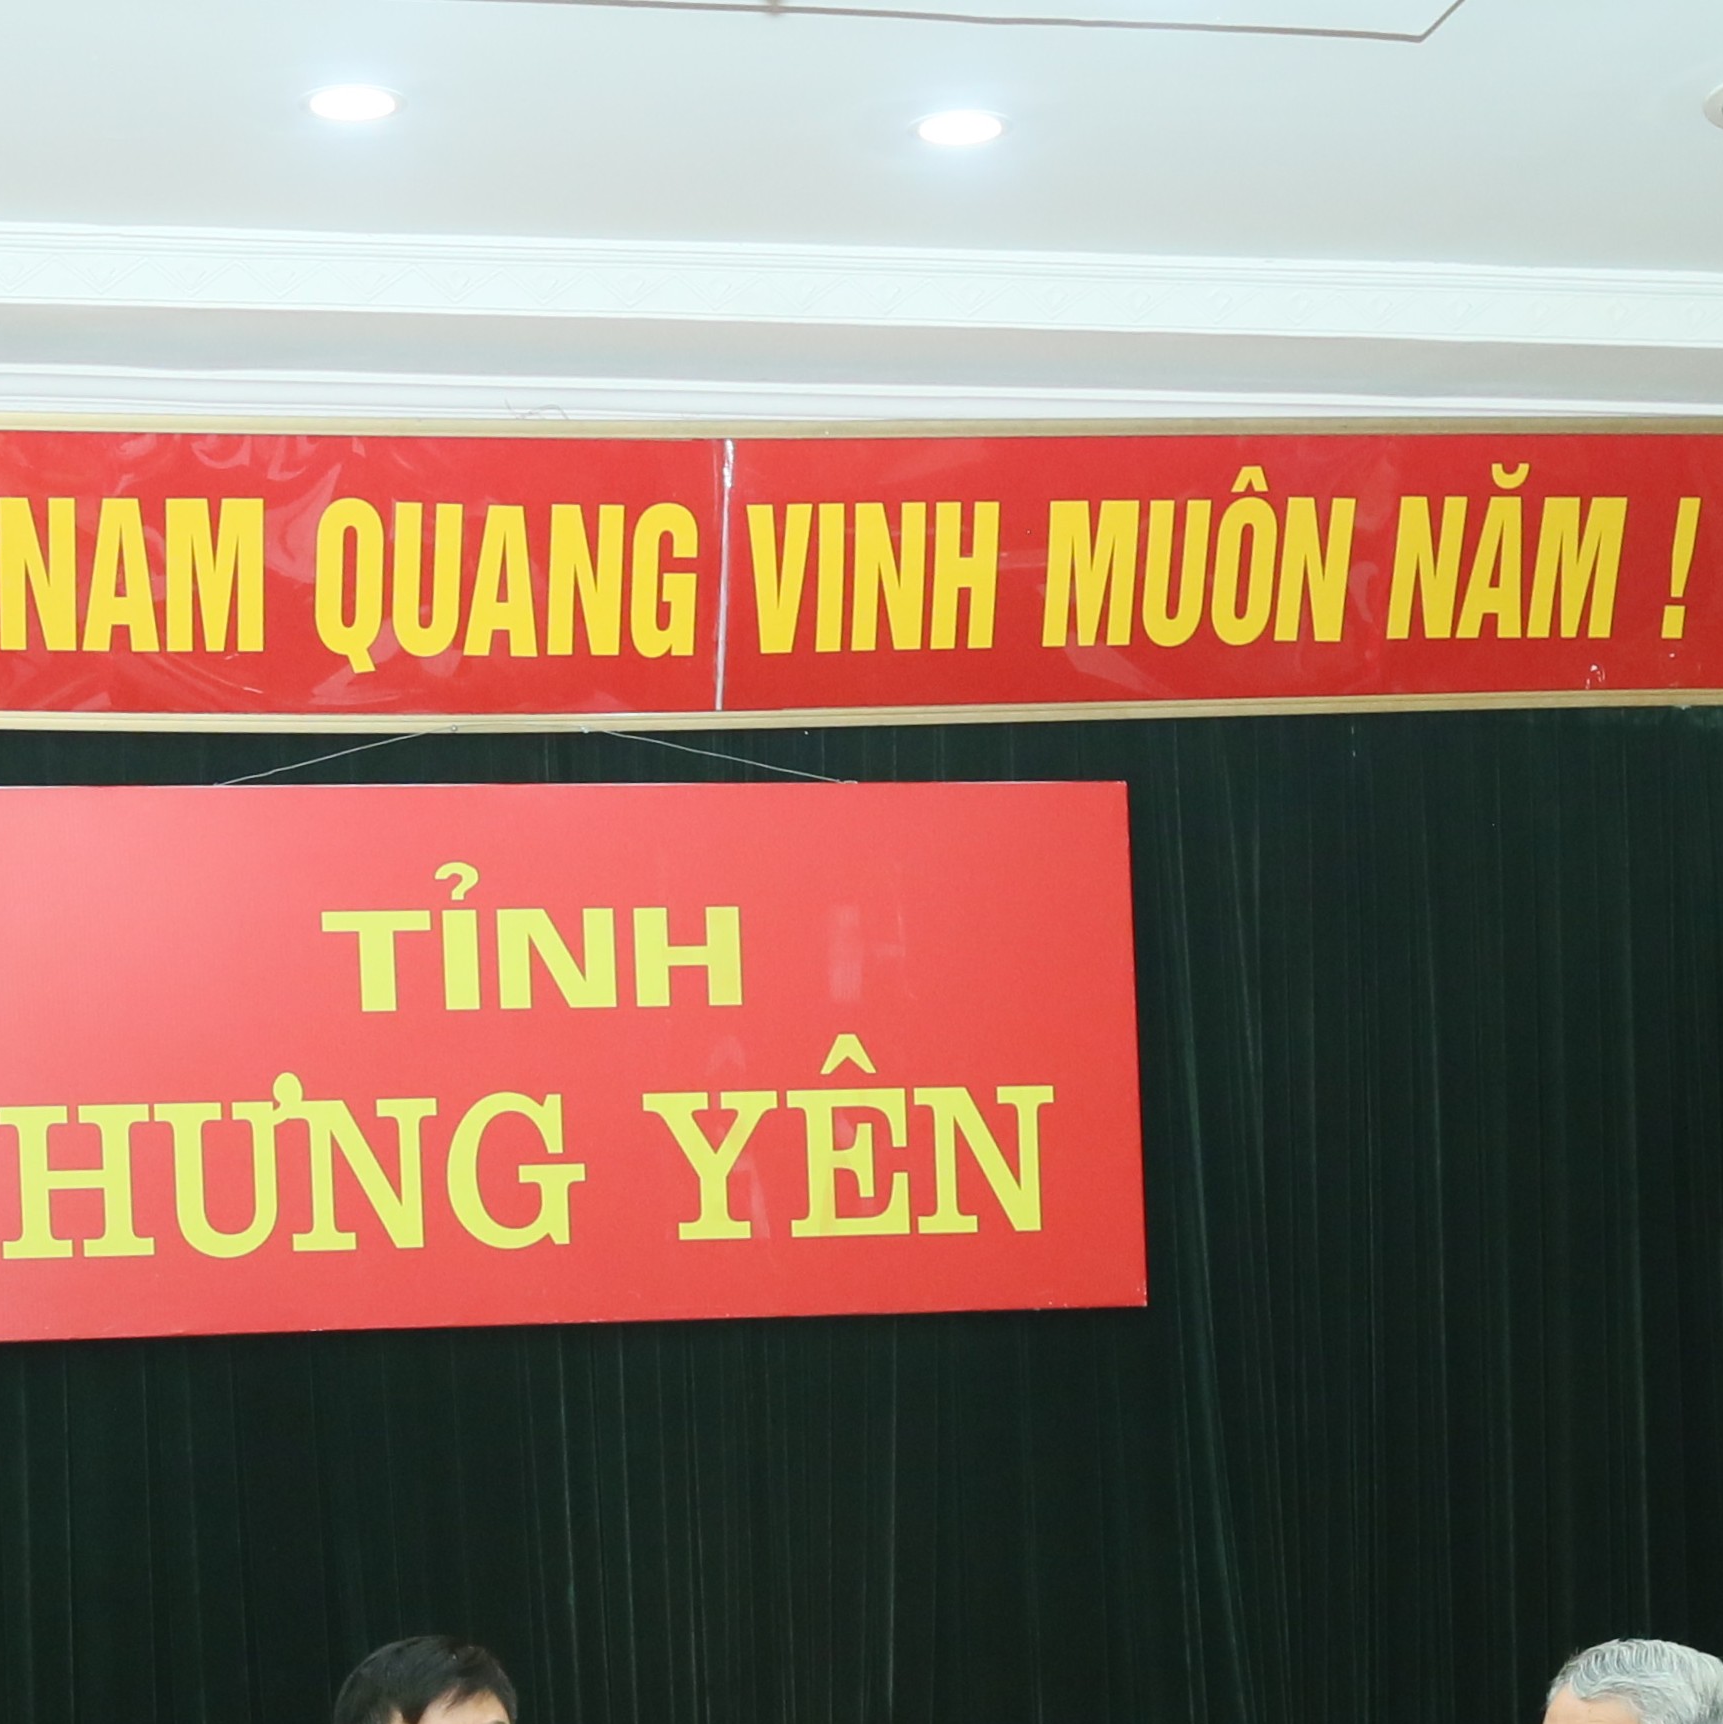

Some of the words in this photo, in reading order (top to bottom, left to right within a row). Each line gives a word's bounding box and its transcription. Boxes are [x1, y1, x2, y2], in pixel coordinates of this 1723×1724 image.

[314, 498, 698, 675] QUANG
[747, 502, 1000, 655] VINH
[1042, 465, 1356, 647] MUÔN
[1386, 463, 1626, 640] NĂM
[321, 861, 742, 1012] TỈNH
[642, 1033, 1054, 1240] YÊN
